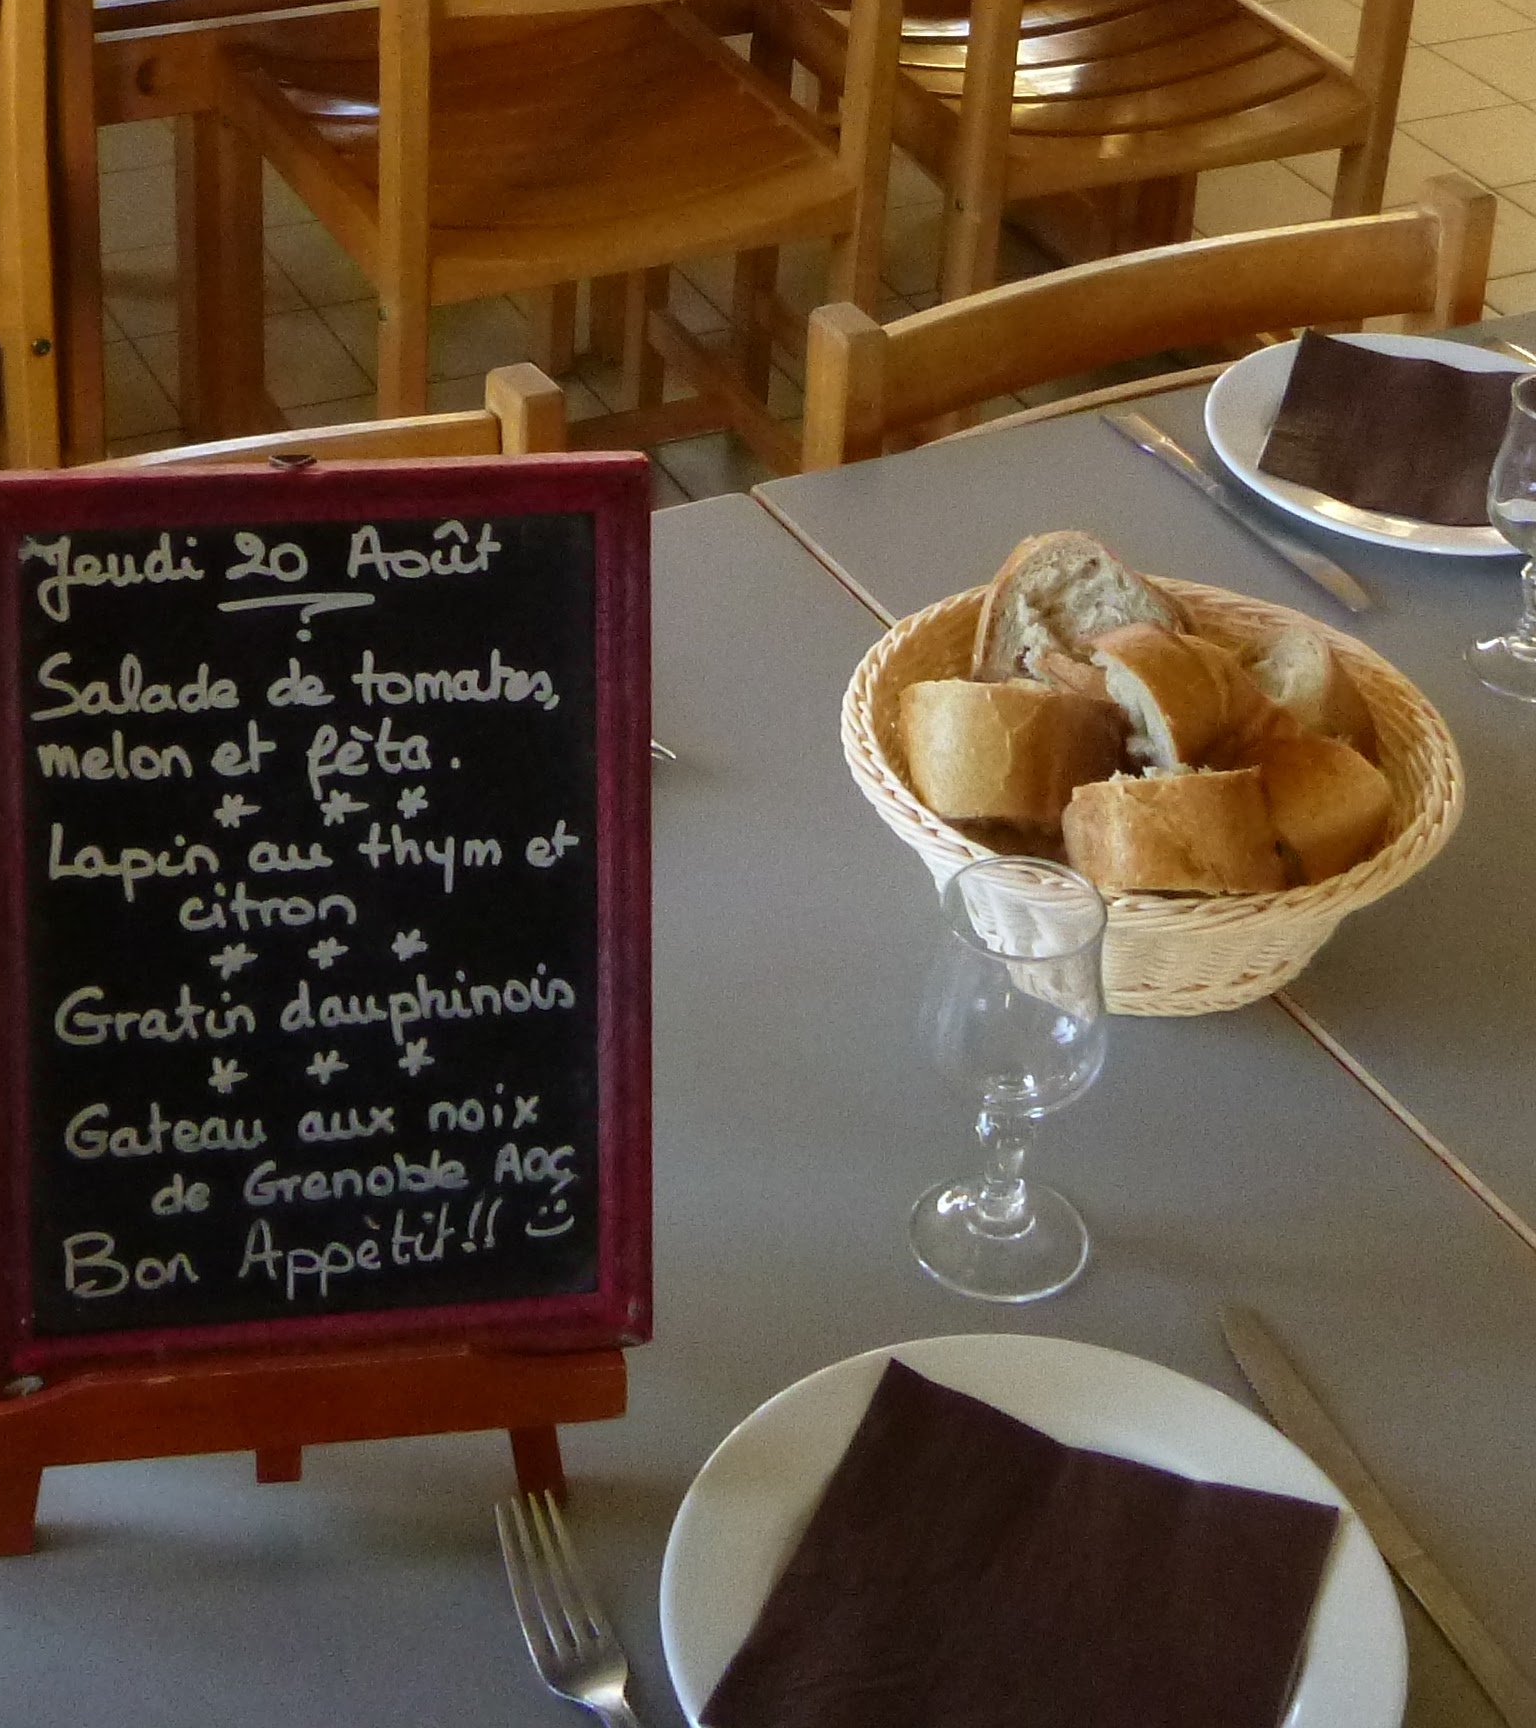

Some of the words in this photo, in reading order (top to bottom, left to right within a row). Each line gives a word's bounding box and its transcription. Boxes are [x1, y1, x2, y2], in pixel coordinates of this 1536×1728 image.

[22, 533, 204, 621] Jeudi
[226, 532, 307, 581] 20
[348, 520, 501, 580] Août
[31, 652, 239, 720] Salade
[267, 658, 335, 706] de
[351, 649, 560, 710] tomates,
[38, 731, 192, 779] melon
[211, 720, 276, 776] et
[50, 823, 225, 902] Lapin
[249, 842, 333, 872] au
[359, 823, 502, 893] thym
[526, 820, 579, 867] et
[180, 882, 356, 930] citron
[56, 985, 255, 1044] Gratin
[281, 963, 574, 1045] dauphinois
[66, 1103, 266, 1156] Gateau
[298, 1107, 394, 1140] aux
[429, 1084, 538, 1130] noix
[152, 1174, 209, 1214] de
[245, 1150, 468, 1204] Grenoble
[64, 1233, 198, 1297] Bon
